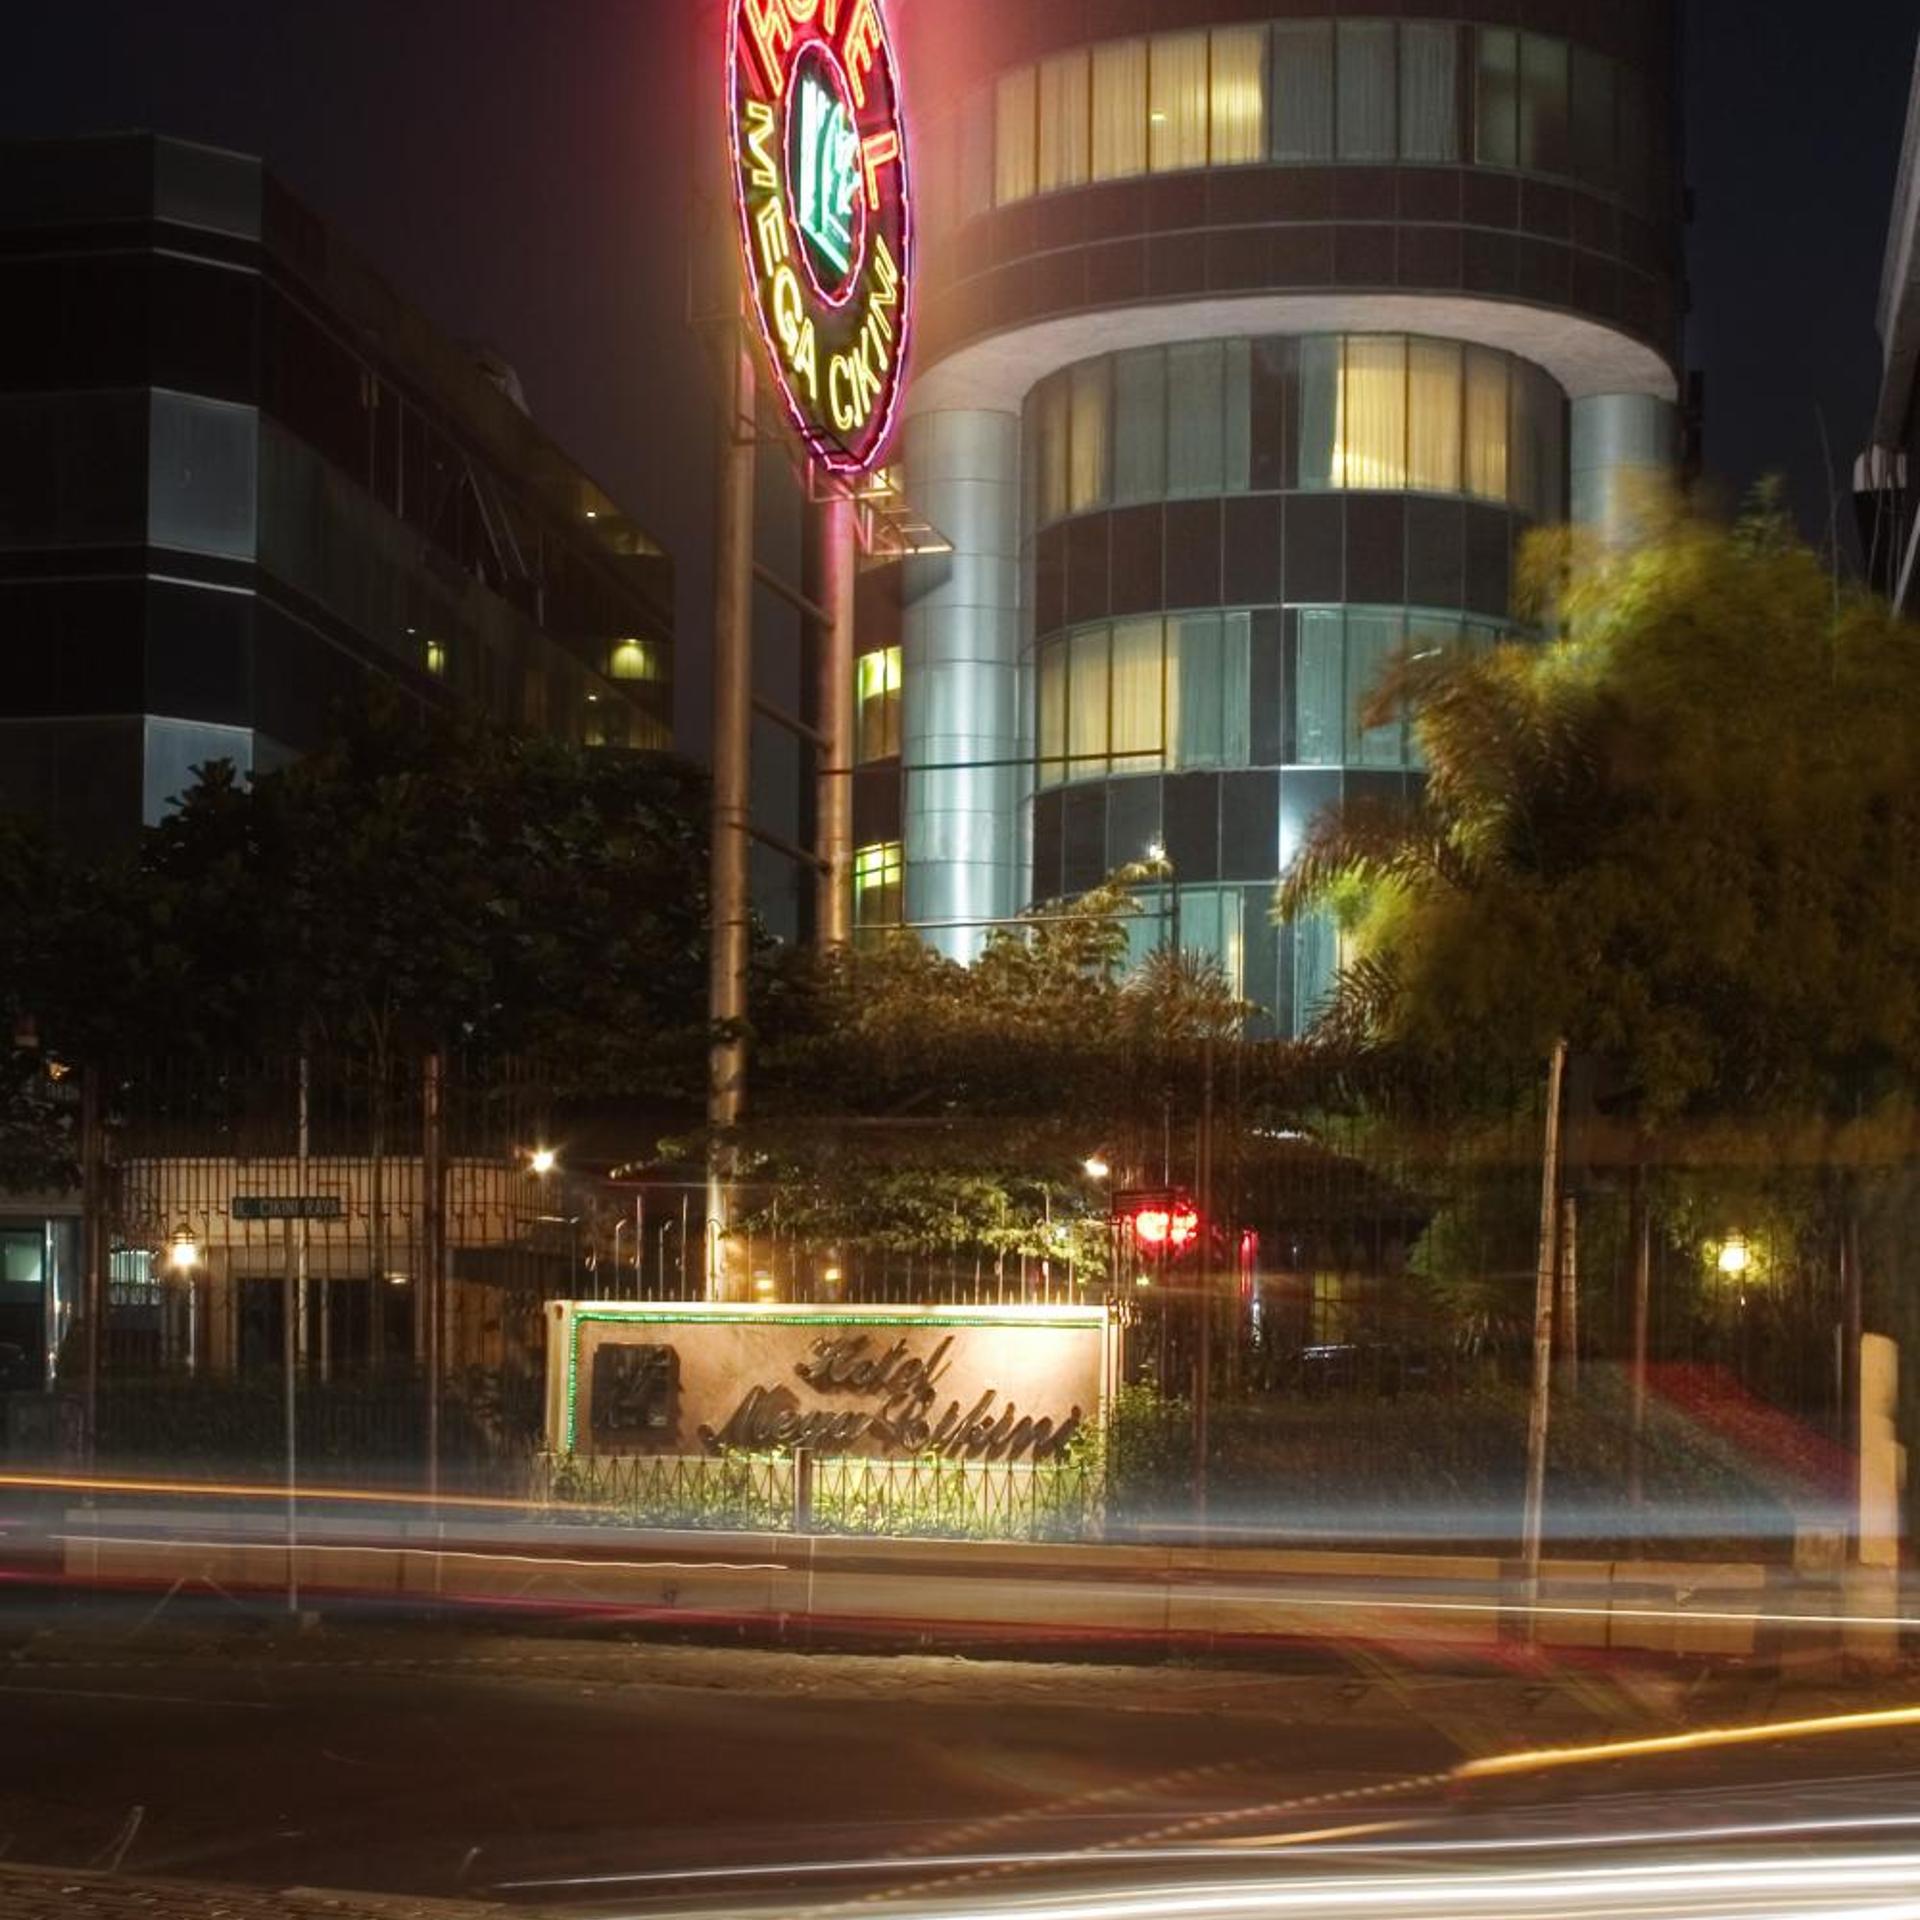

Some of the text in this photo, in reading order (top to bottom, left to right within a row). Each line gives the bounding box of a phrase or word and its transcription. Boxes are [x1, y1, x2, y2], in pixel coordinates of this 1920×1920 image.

[745, 100, 899, 430] MEGA CIKINI
[795, 1335, 955, 1396] Hotel
[698, 1384, 876, 1455] Mega
